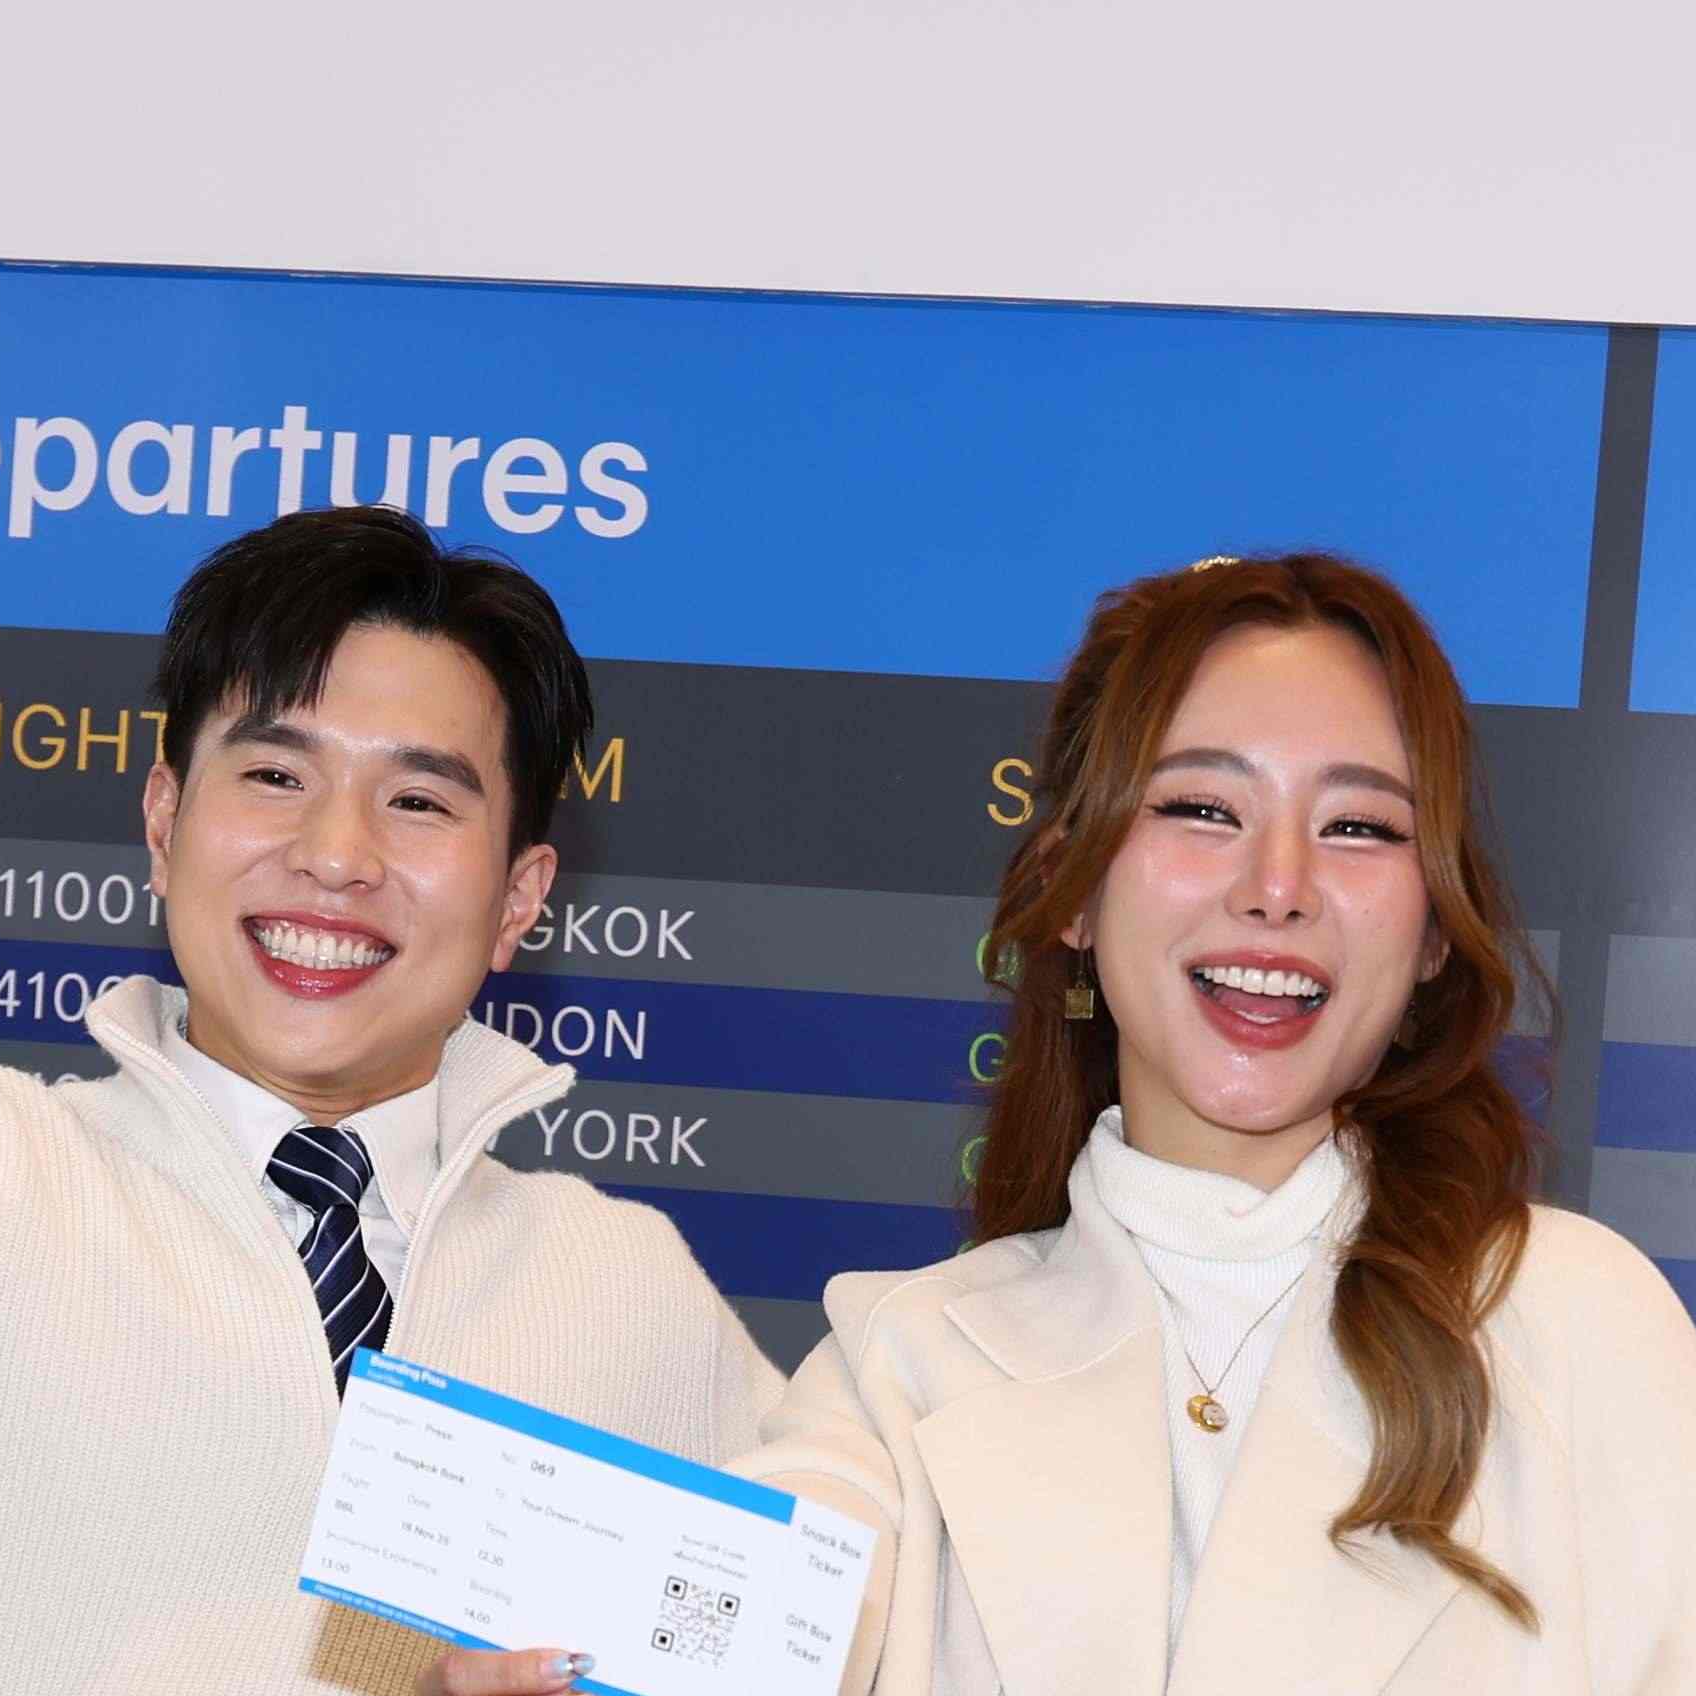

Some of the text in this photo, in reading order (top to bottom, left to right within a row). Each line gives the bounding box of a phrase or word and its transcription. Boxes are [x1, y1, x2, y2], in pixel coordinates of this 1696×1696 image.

[518, 903, 695, 960] GKOK
[534, 1107, 708, 1168] YORK
[369, 1354, 421, 1382] Boarding
[391, 1449, 439, 1477] Bangkok
[439, 1466, 465, 1485] Bank
[529, 1458, 556, 1479] 069
[799, 1522, 863, 1560] Snack Box
[806, 1552, 845, 1579] Ticket
[784, 1611, 833, 1644] Gift Box
[784, 1638, 823, 1666] Ticket
